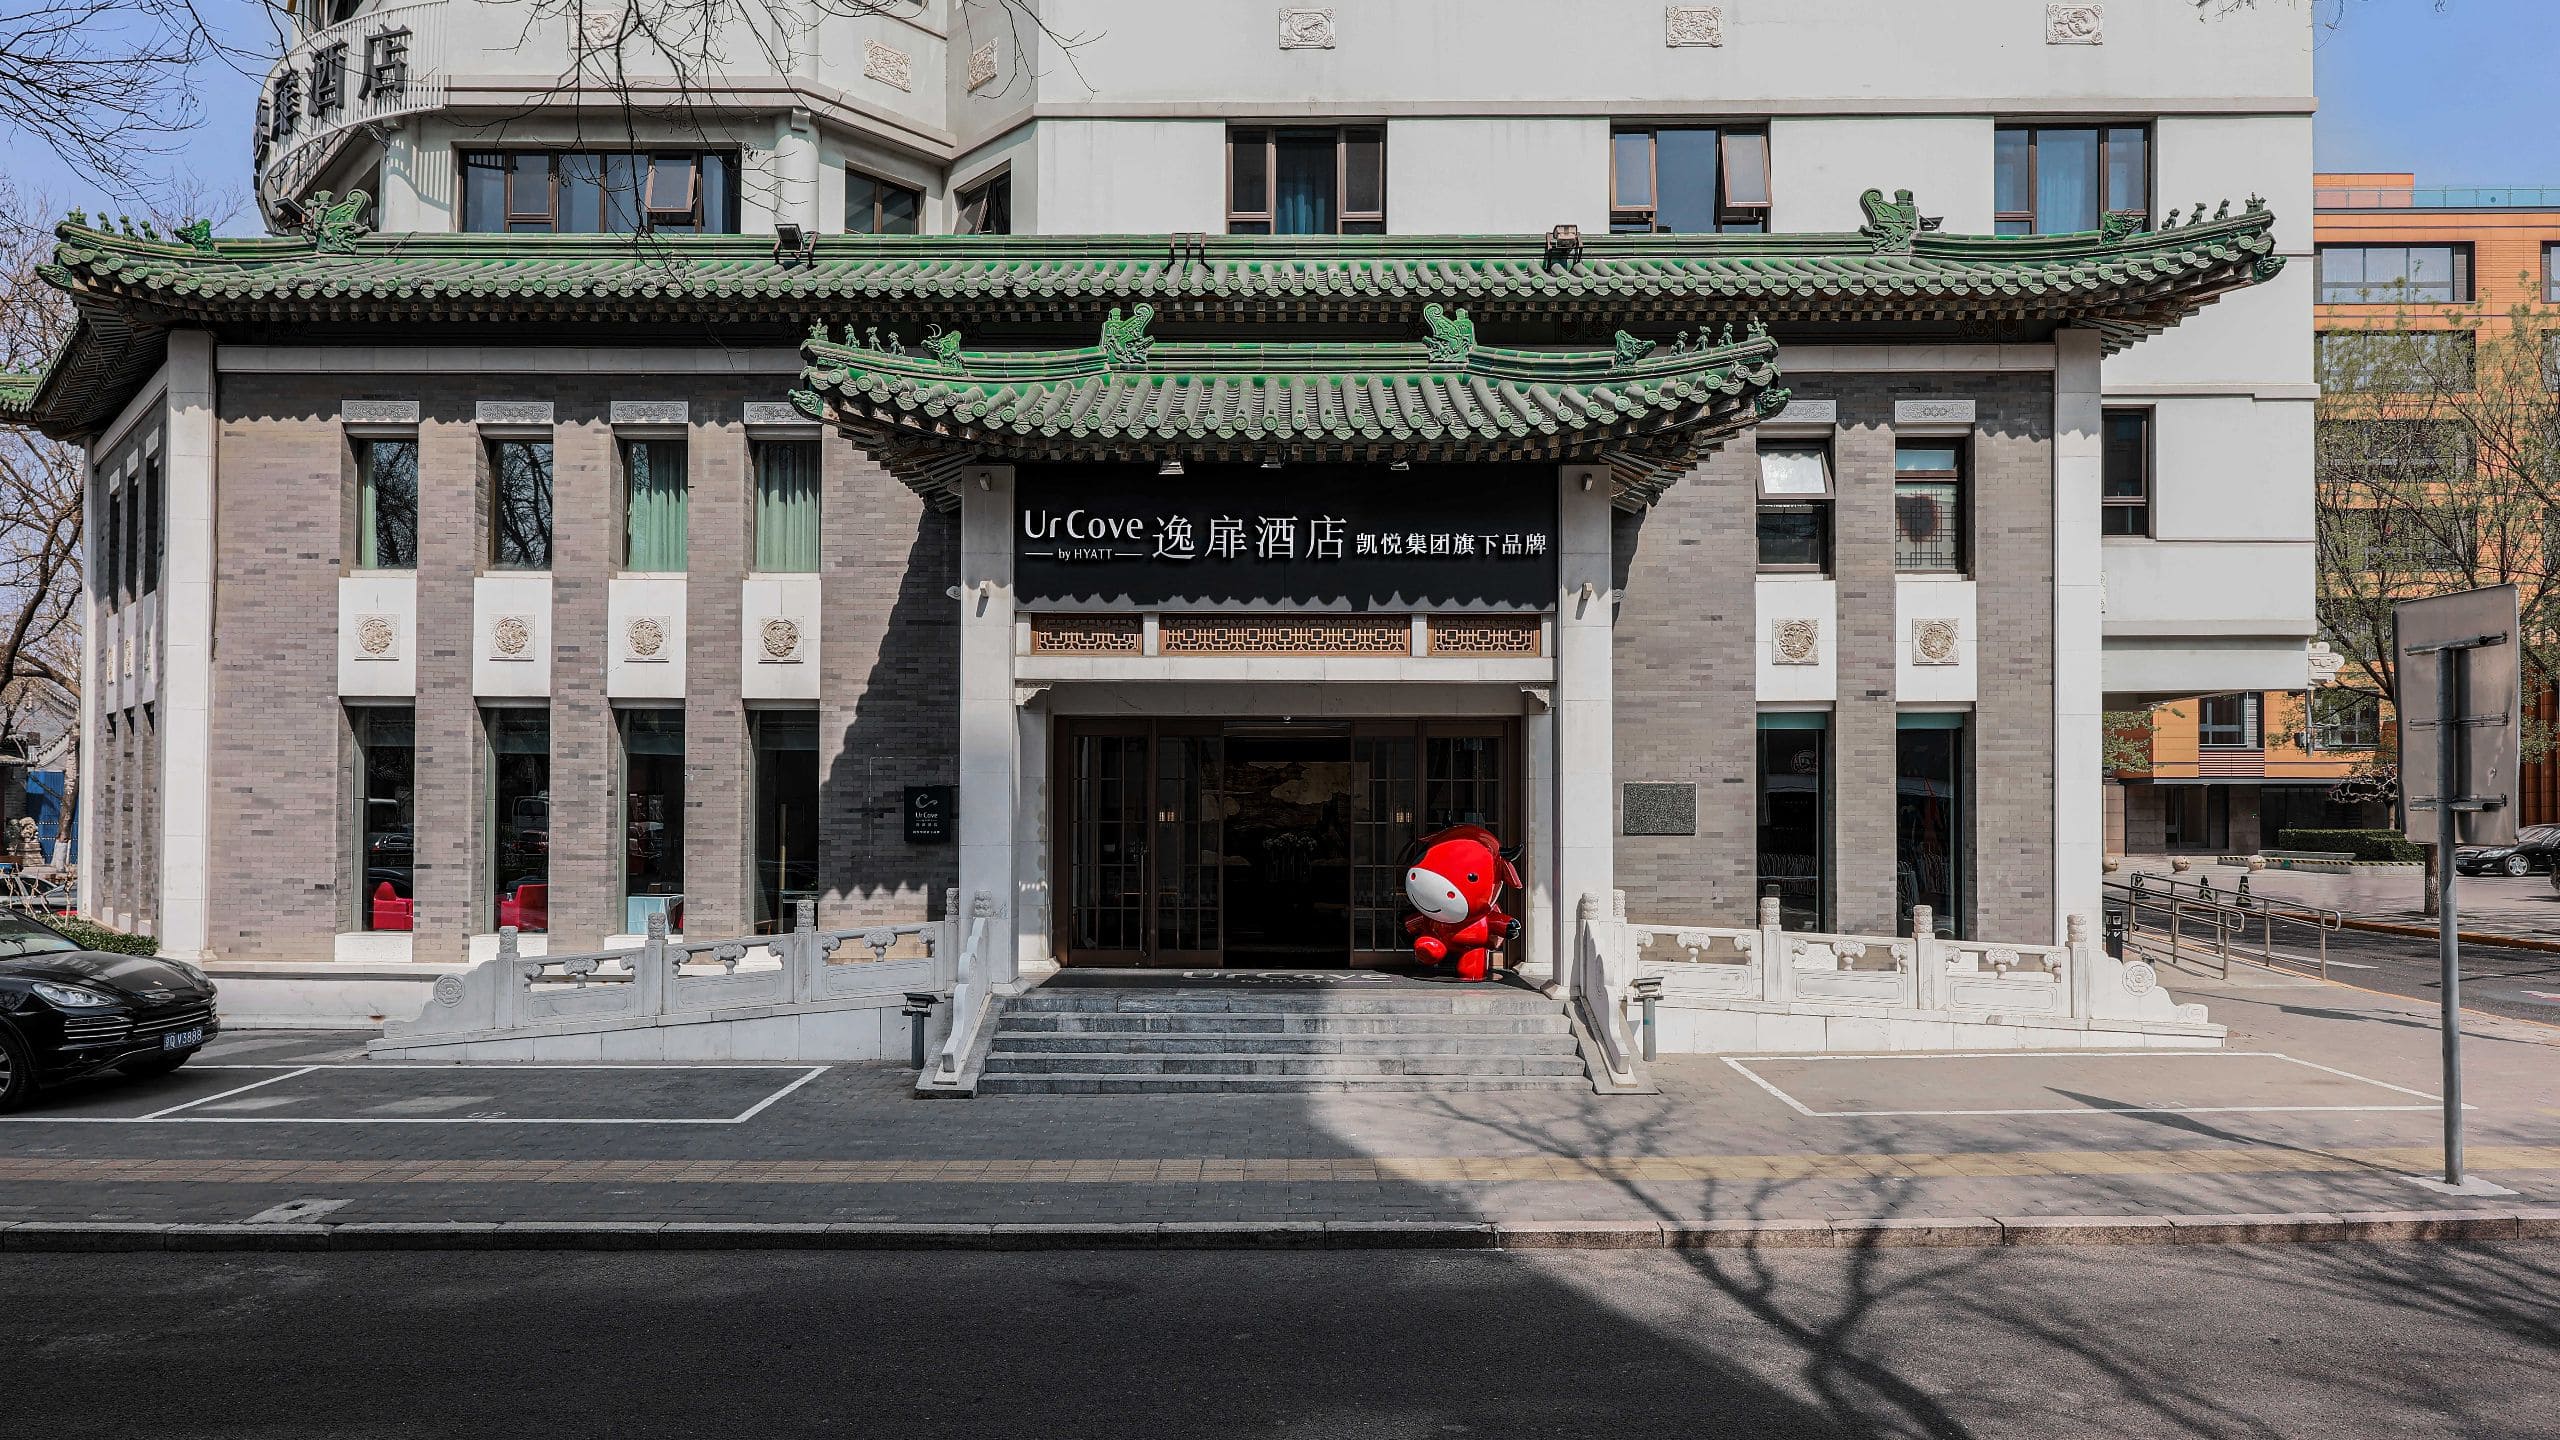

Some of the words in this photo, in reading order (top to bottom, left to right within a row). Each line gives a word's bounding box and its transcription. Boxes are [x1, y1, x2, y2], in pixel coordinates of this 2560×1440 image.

[1025, 509, 1144, 539] UrCove
[1151, 514, 1347, 559] 逸扉酒店
[1058, 548, 1071, 561] by
[1074, 548, 1113, 560] HYATT
[1356, 532, 1547, 555] 凯悦集团旗下品牌
